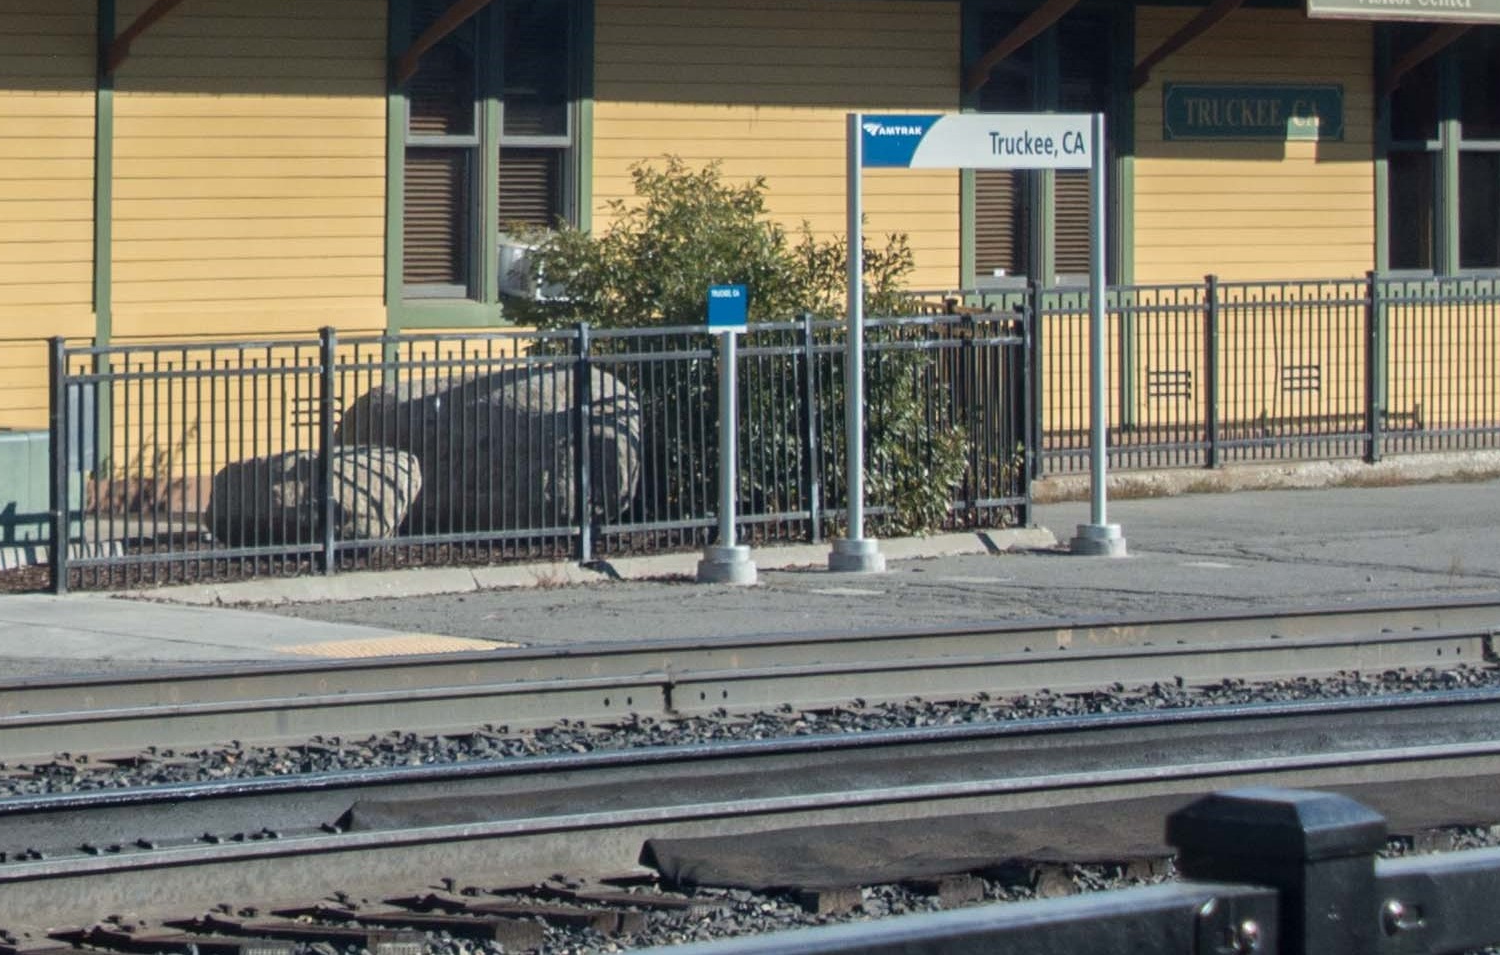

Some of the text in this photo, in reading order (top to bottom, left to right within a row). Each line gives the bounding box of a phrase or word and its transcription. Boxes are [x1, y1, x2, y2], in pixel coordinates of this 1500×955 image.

[879, 125, 922, 136] AMTRAK
[988, 129, 1086, 159] Truckee, CA
